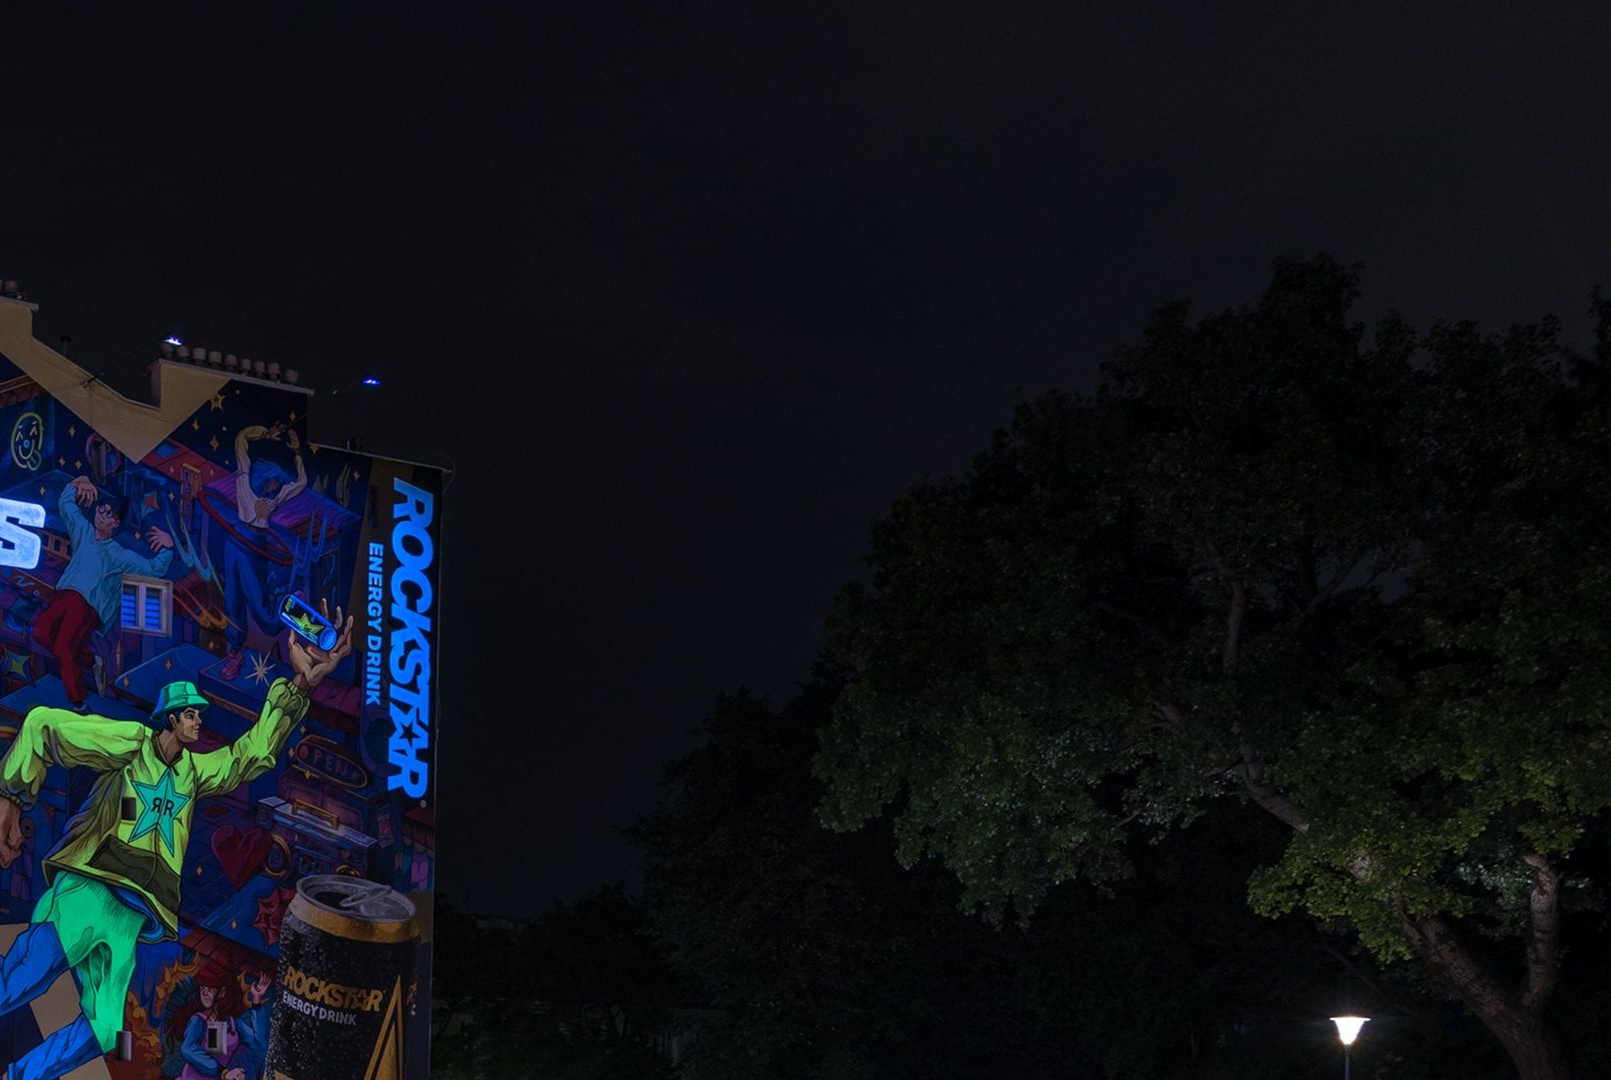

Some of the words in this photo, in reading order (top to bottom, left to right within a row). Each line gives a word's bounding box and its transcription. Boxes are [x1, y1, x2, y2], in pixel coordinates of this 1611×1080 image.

[366, 542, 384, 636] ENERGY
[364, 637, 383, 706] DRINK
[387, 476, 434, 800] ROCKSTAR
[282, 991, 319, 1017] ENERGY
[319, 1008, 357, 1027] DRINK
[283, 965, 384, 1013] ROCKSTAR
